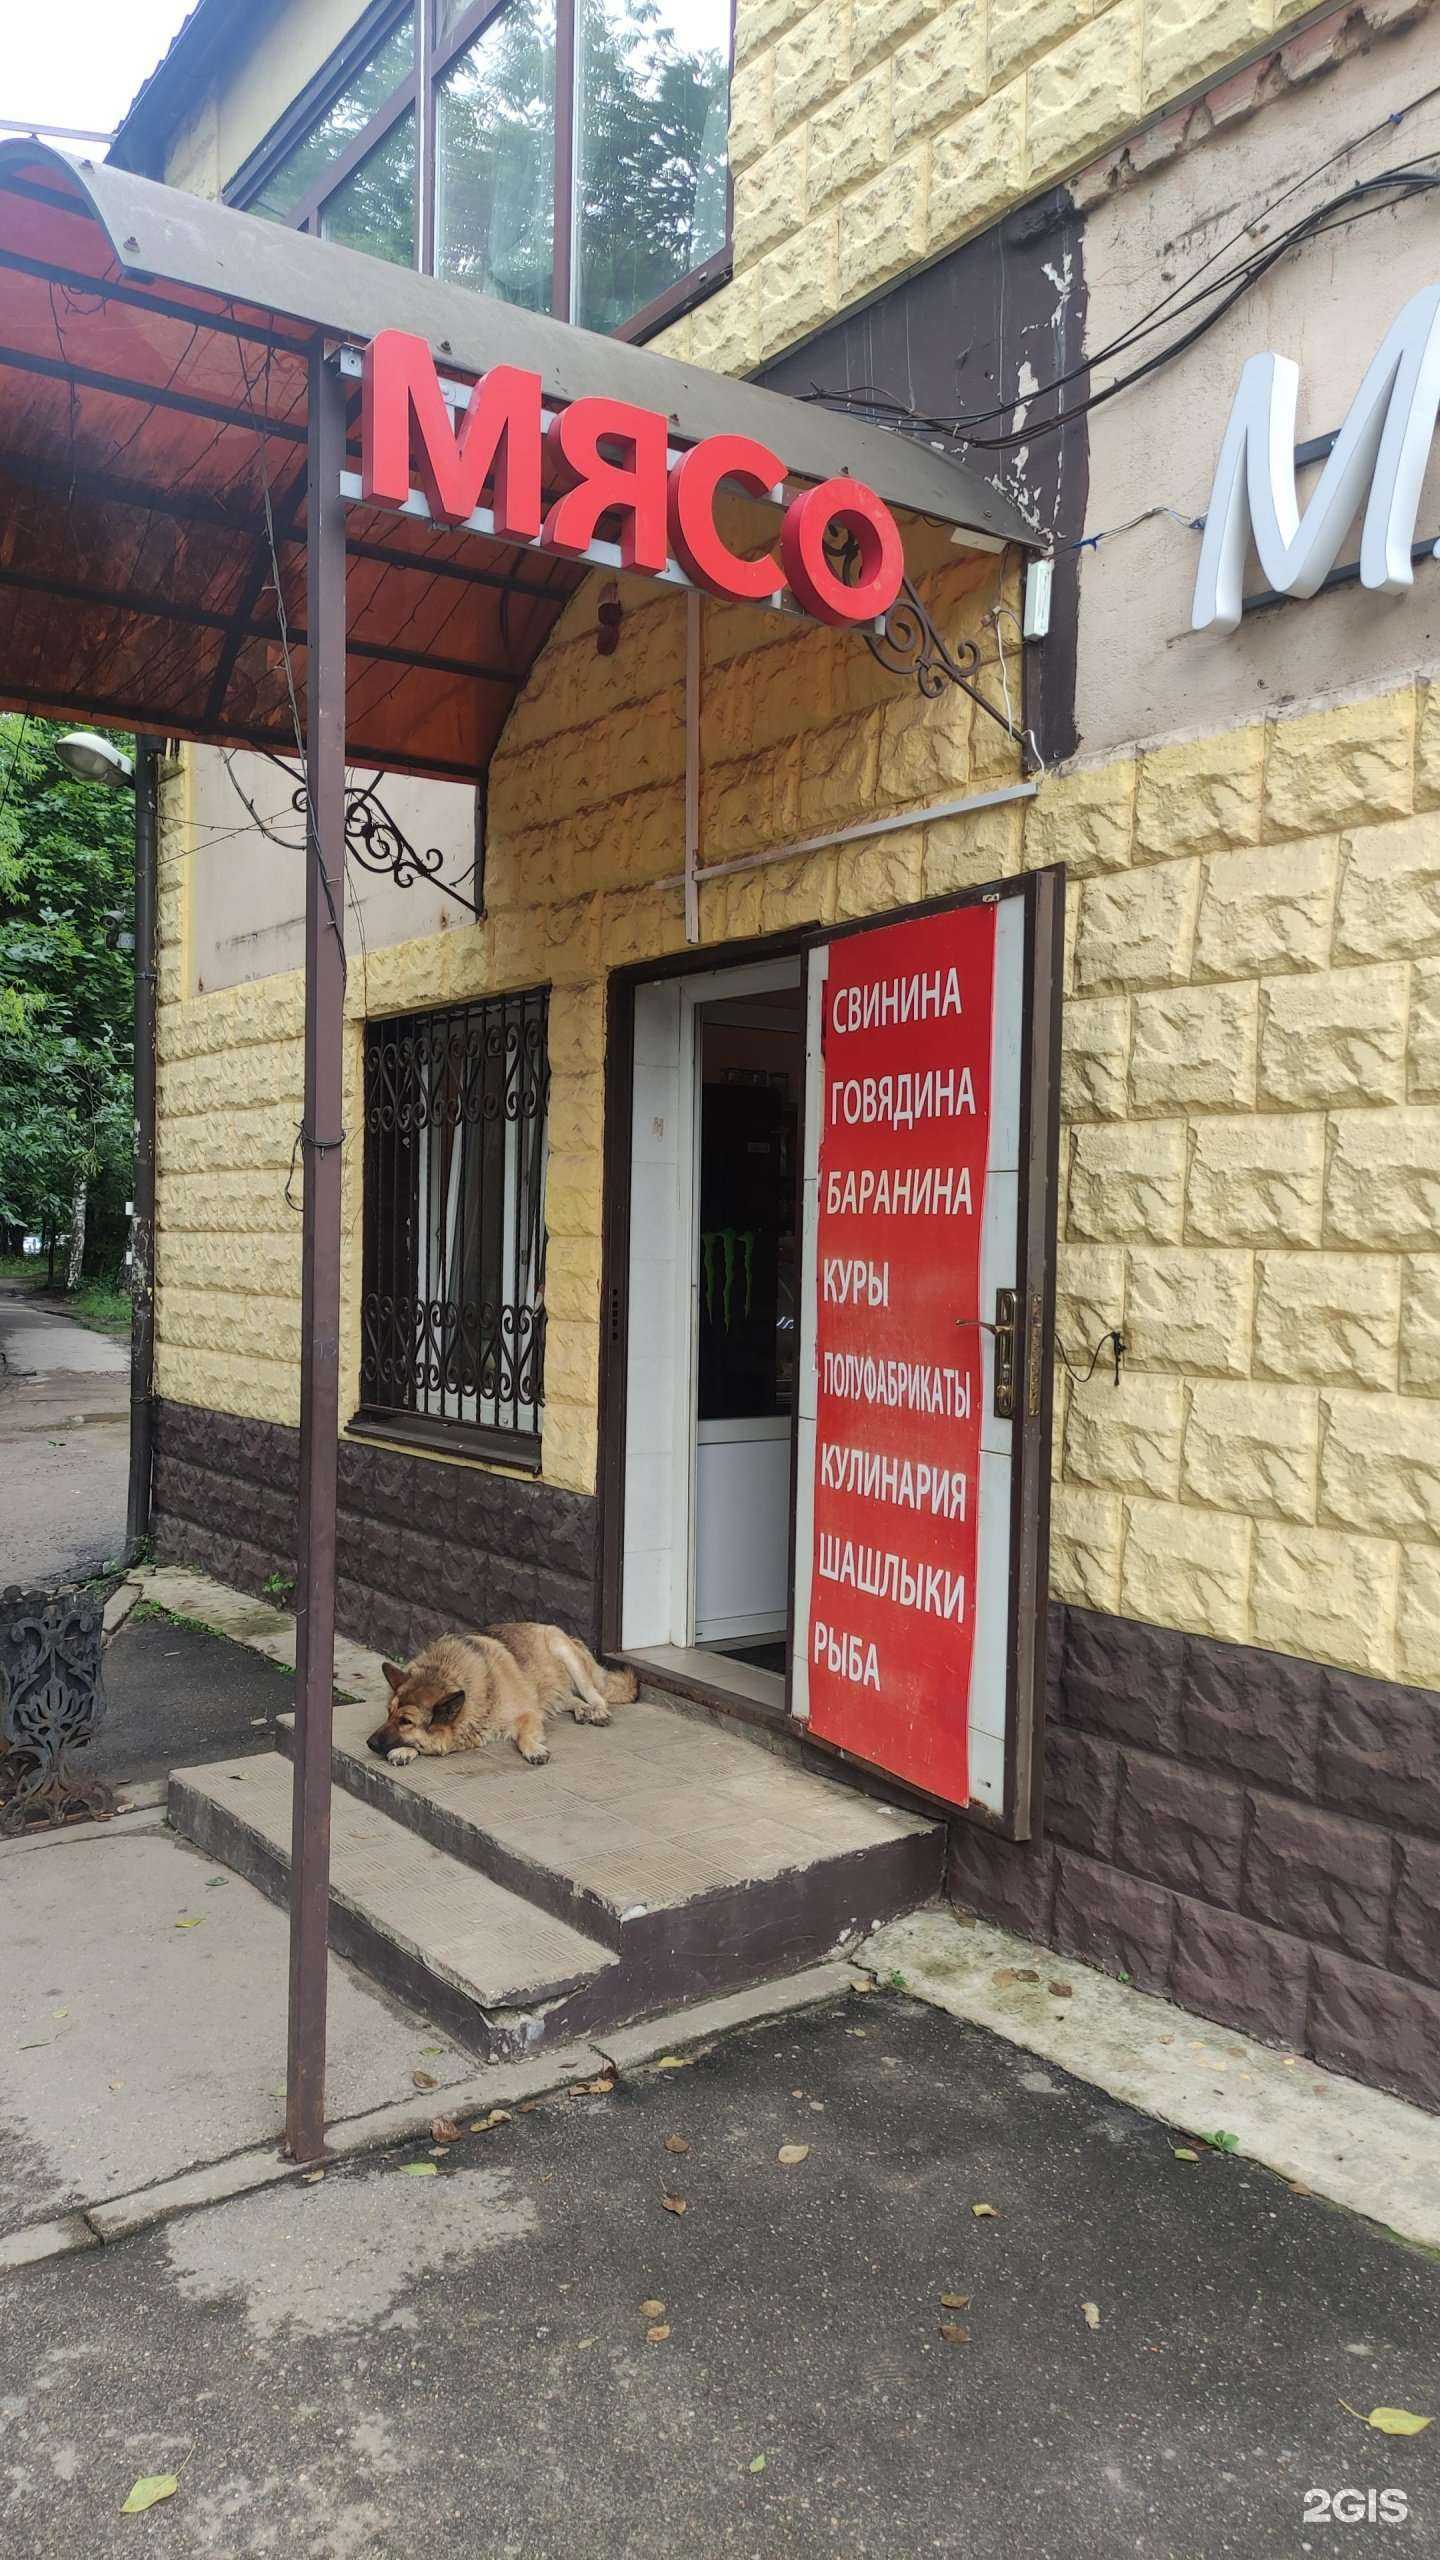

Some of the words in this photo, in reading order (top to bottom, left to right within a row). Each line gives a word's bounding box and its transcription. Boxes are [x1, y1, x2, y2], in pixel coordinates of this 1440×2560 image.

[363, 328, 904, 627] МЯСО
[1192, 283, 1440, 634] М
[832, 967, 962, 1034] СВИНИНА
[831, 1067, 976, 1131] ГОВЯДИНА
[826, 1167, 973, 1216] БАРАНИНА
[823, 1258, 889, 1307] КУРЫ
[823, 1351, 971, 1420] ПОЛУФАБРИКАТЫ
[821, 1442, 967, 1522] КУЛИНАРИЯ
[818, 1533, 966, 1624] ШАШЛЫКИ
[813, 1621, 881, 1692] РЫБА
